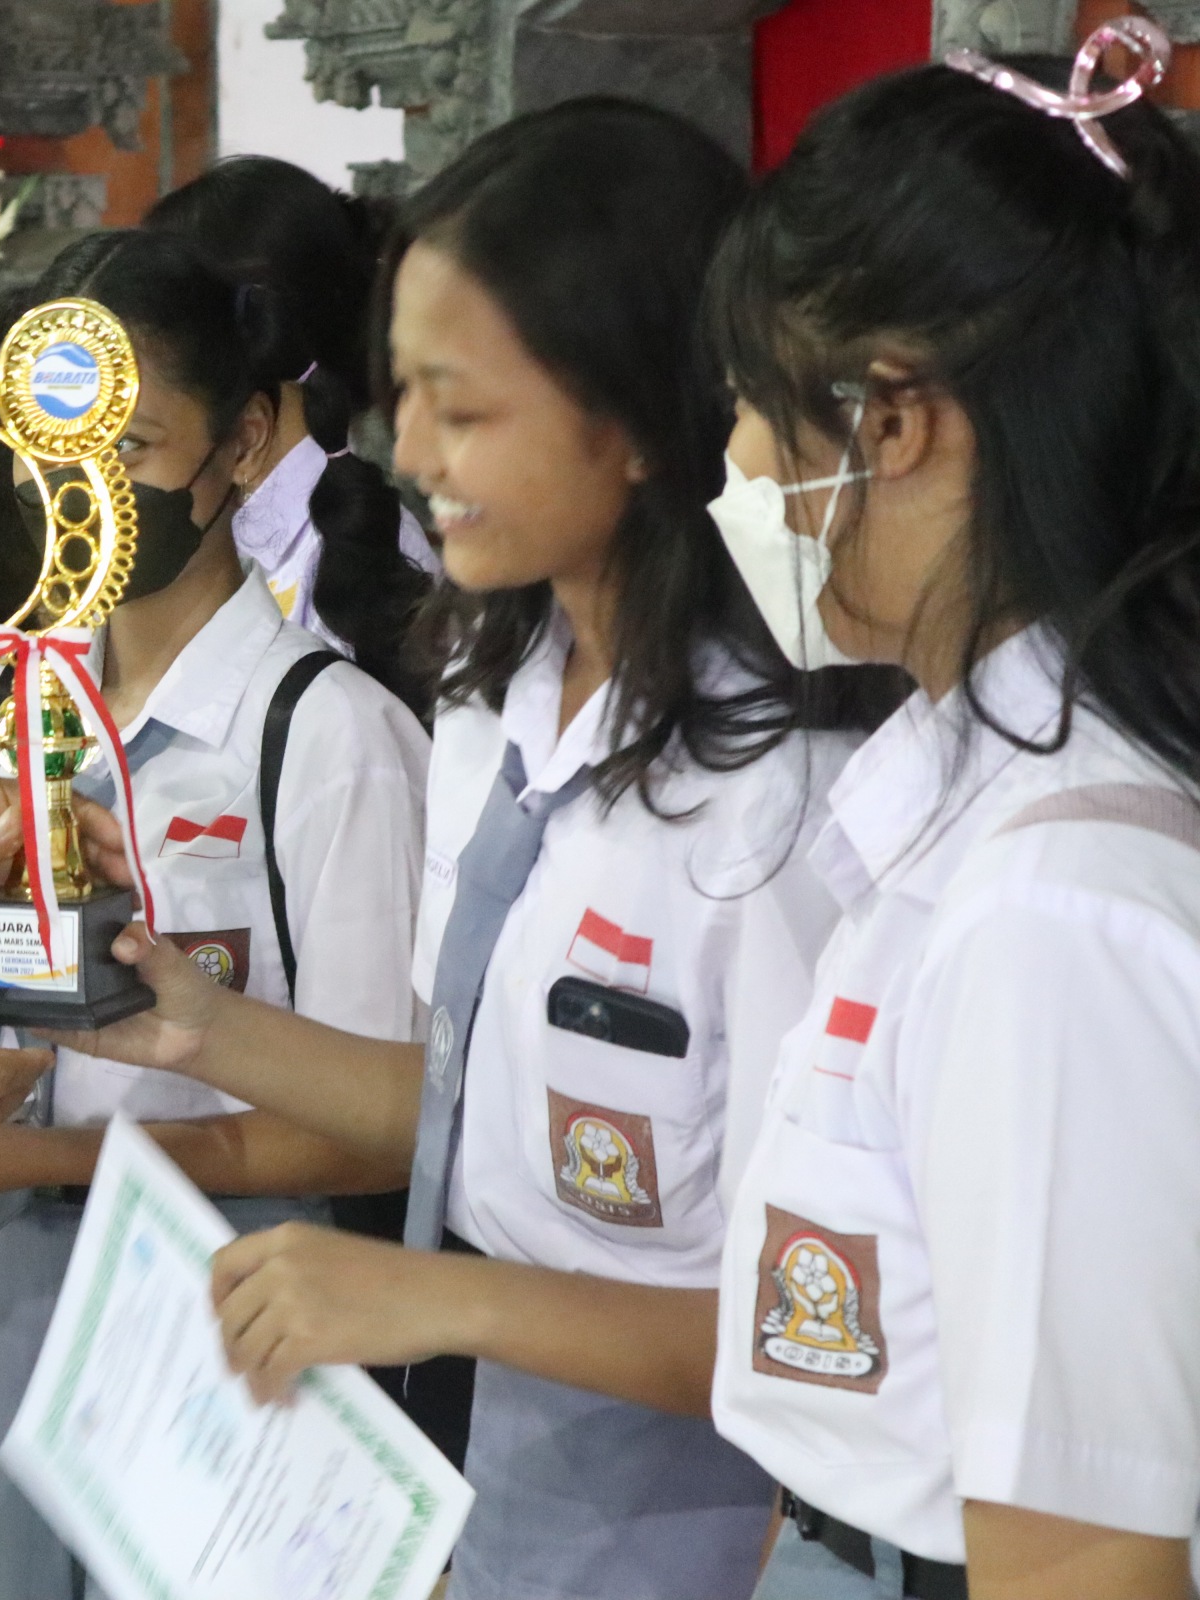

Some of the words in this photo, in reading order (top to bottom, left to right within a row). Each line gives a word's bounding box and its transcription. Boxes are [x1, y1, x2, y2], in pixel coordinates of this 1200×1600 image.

[33, 371, 97, 385] BHARATA
[4, 938, 24, 946] MARS
[1, 966, 19, 974] TAHUN
[20, 967, 35, 975] 2022
[783, 1346, 852, 1371] OSIS
